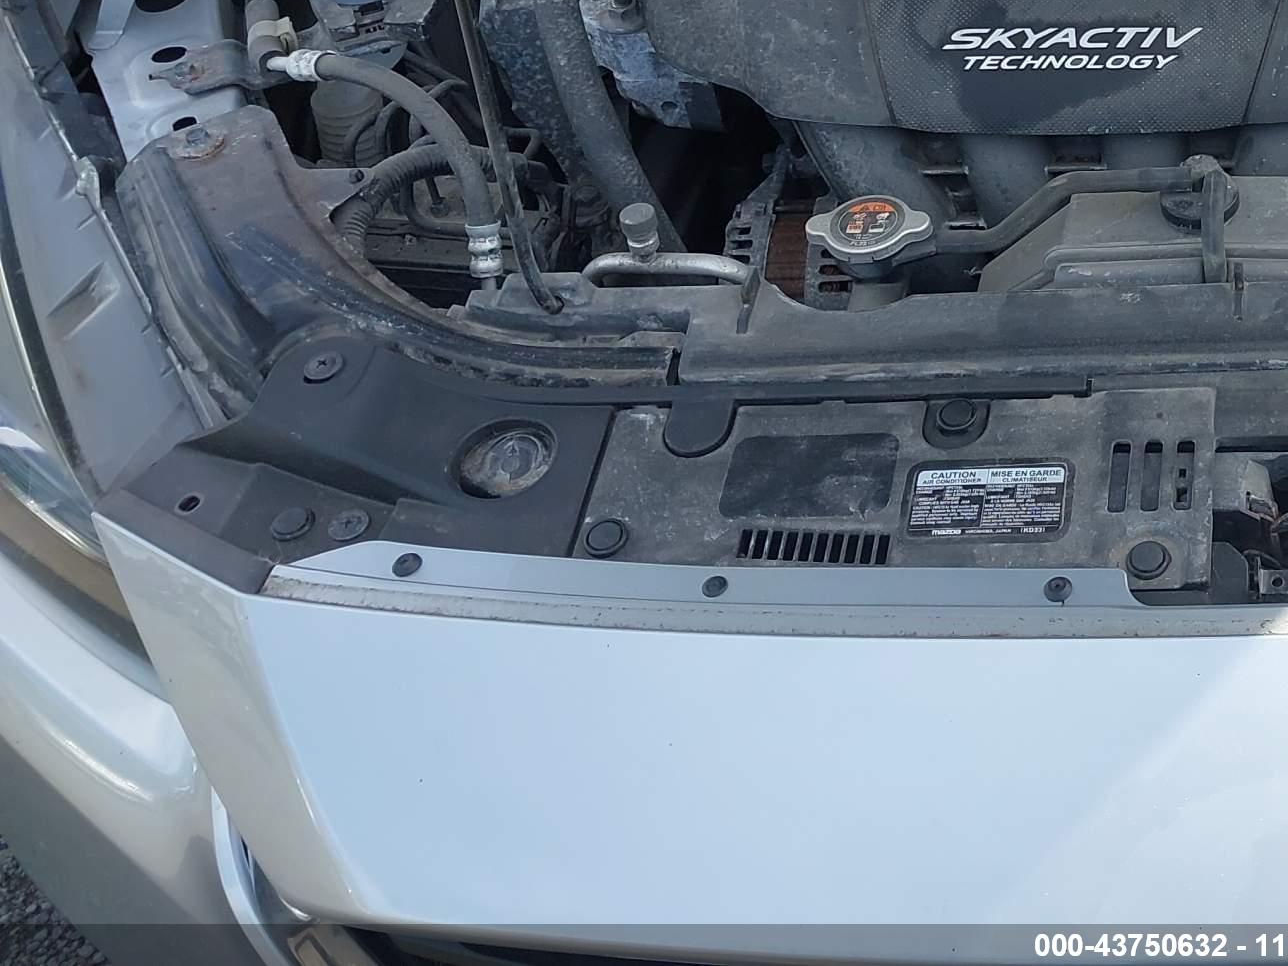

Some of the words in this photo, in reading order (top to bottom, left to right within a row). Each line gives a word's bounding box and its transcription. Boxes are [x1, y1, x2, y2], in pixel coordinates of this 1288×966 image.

[942, 27, 1203, 50] SKYACTIV
[963, 55, 1179, 70] TECHNOLOGY
[930, 471, 977, 480] CAUTION
[990, 470, 1013, 478] MISE
[1029, 469, 1062, 477] GARDE
